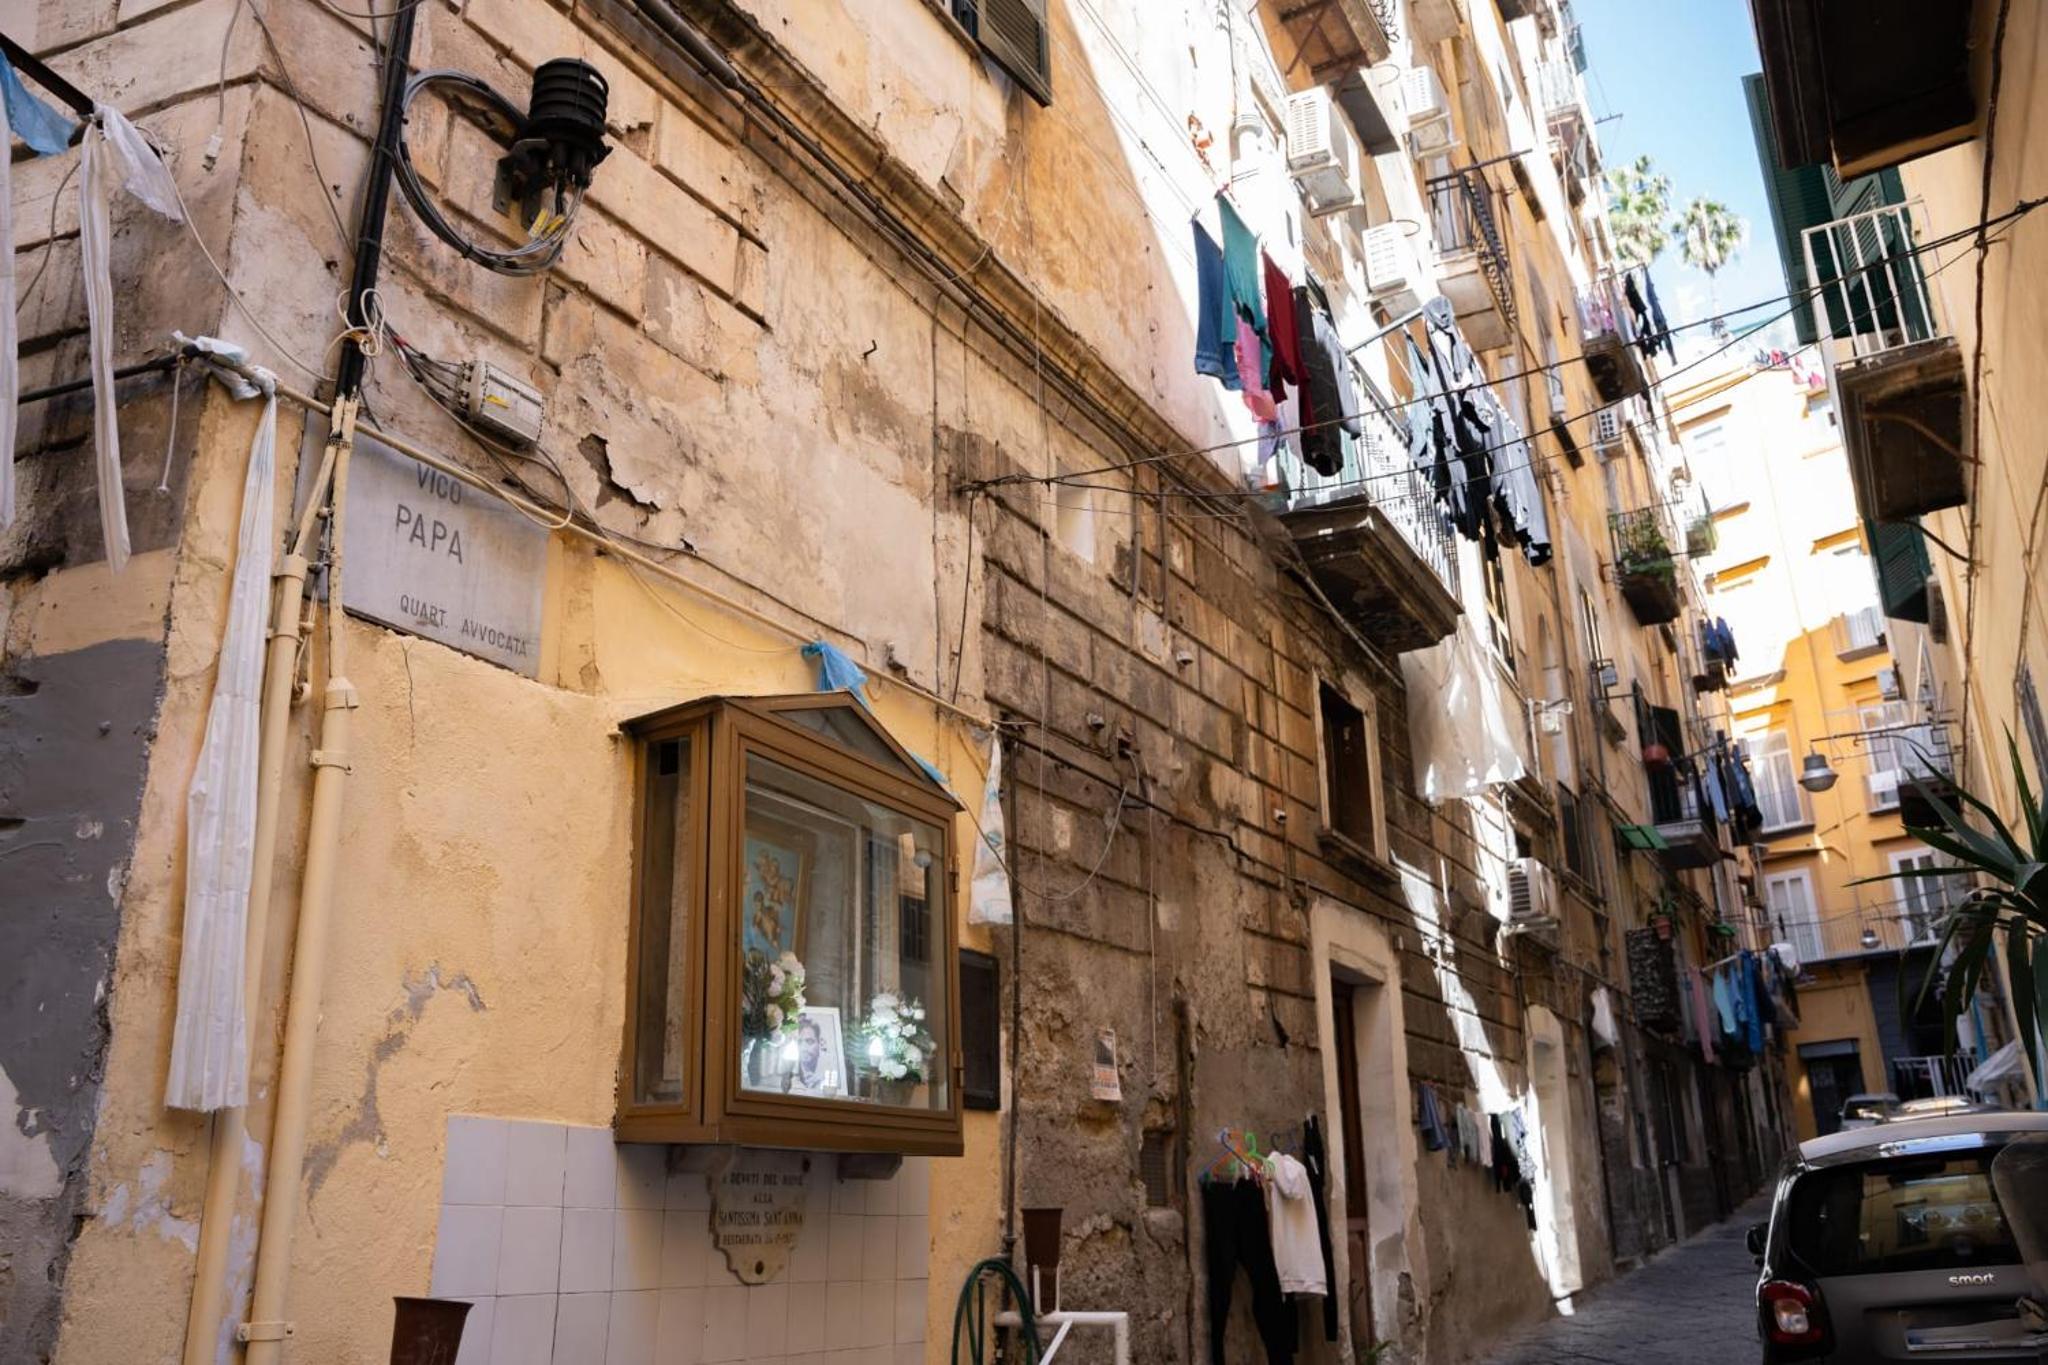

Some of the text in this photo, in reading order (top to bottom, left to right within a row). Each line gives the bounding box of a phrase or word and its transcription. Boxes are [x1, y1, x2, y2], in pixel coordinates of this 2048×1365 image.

[416, 463, 462, 505] VICO
[395, 504, 463, 565] PAPA
[400, 594, 528, 657] QUART. AVVOCATA
[1949, 1273, 1995, 1287] smart
